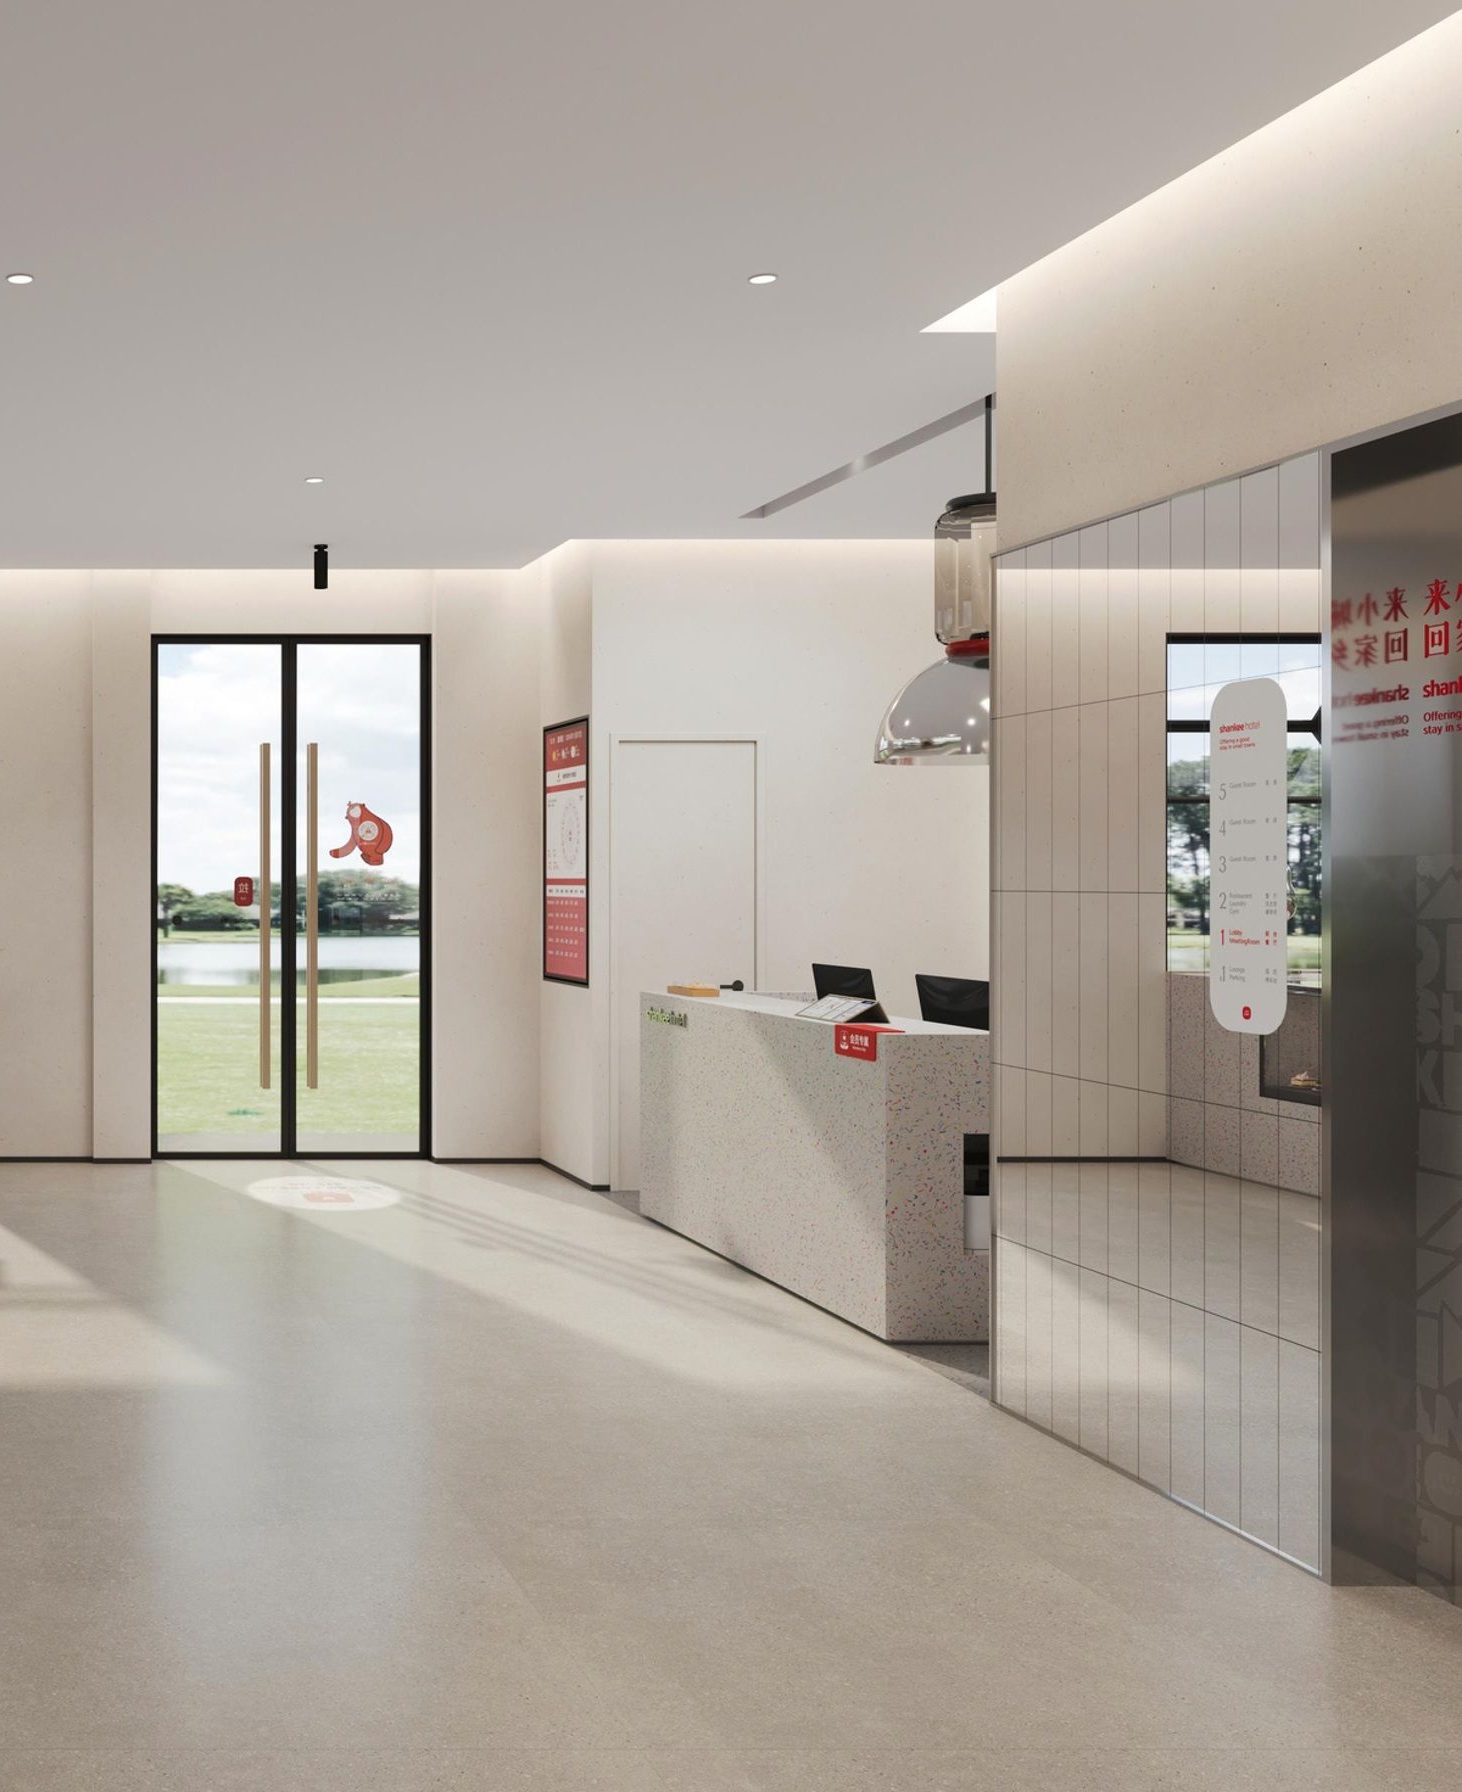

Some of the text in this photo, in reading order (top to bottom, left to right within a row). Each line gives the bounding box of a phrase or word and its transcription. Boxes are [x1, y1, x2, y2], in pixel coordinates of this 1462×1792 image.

[1423, 725, 1443, 736] stay
[1445, 723, 1454, 732] in
[1219, 783, 1227, 800] 5
[1219, 819, 1227, 836] 4
[1219, 856, 1227, 873] 3
[1219, 892, 1227, 909] 2
[1220, 928, 1225, 946] 1
